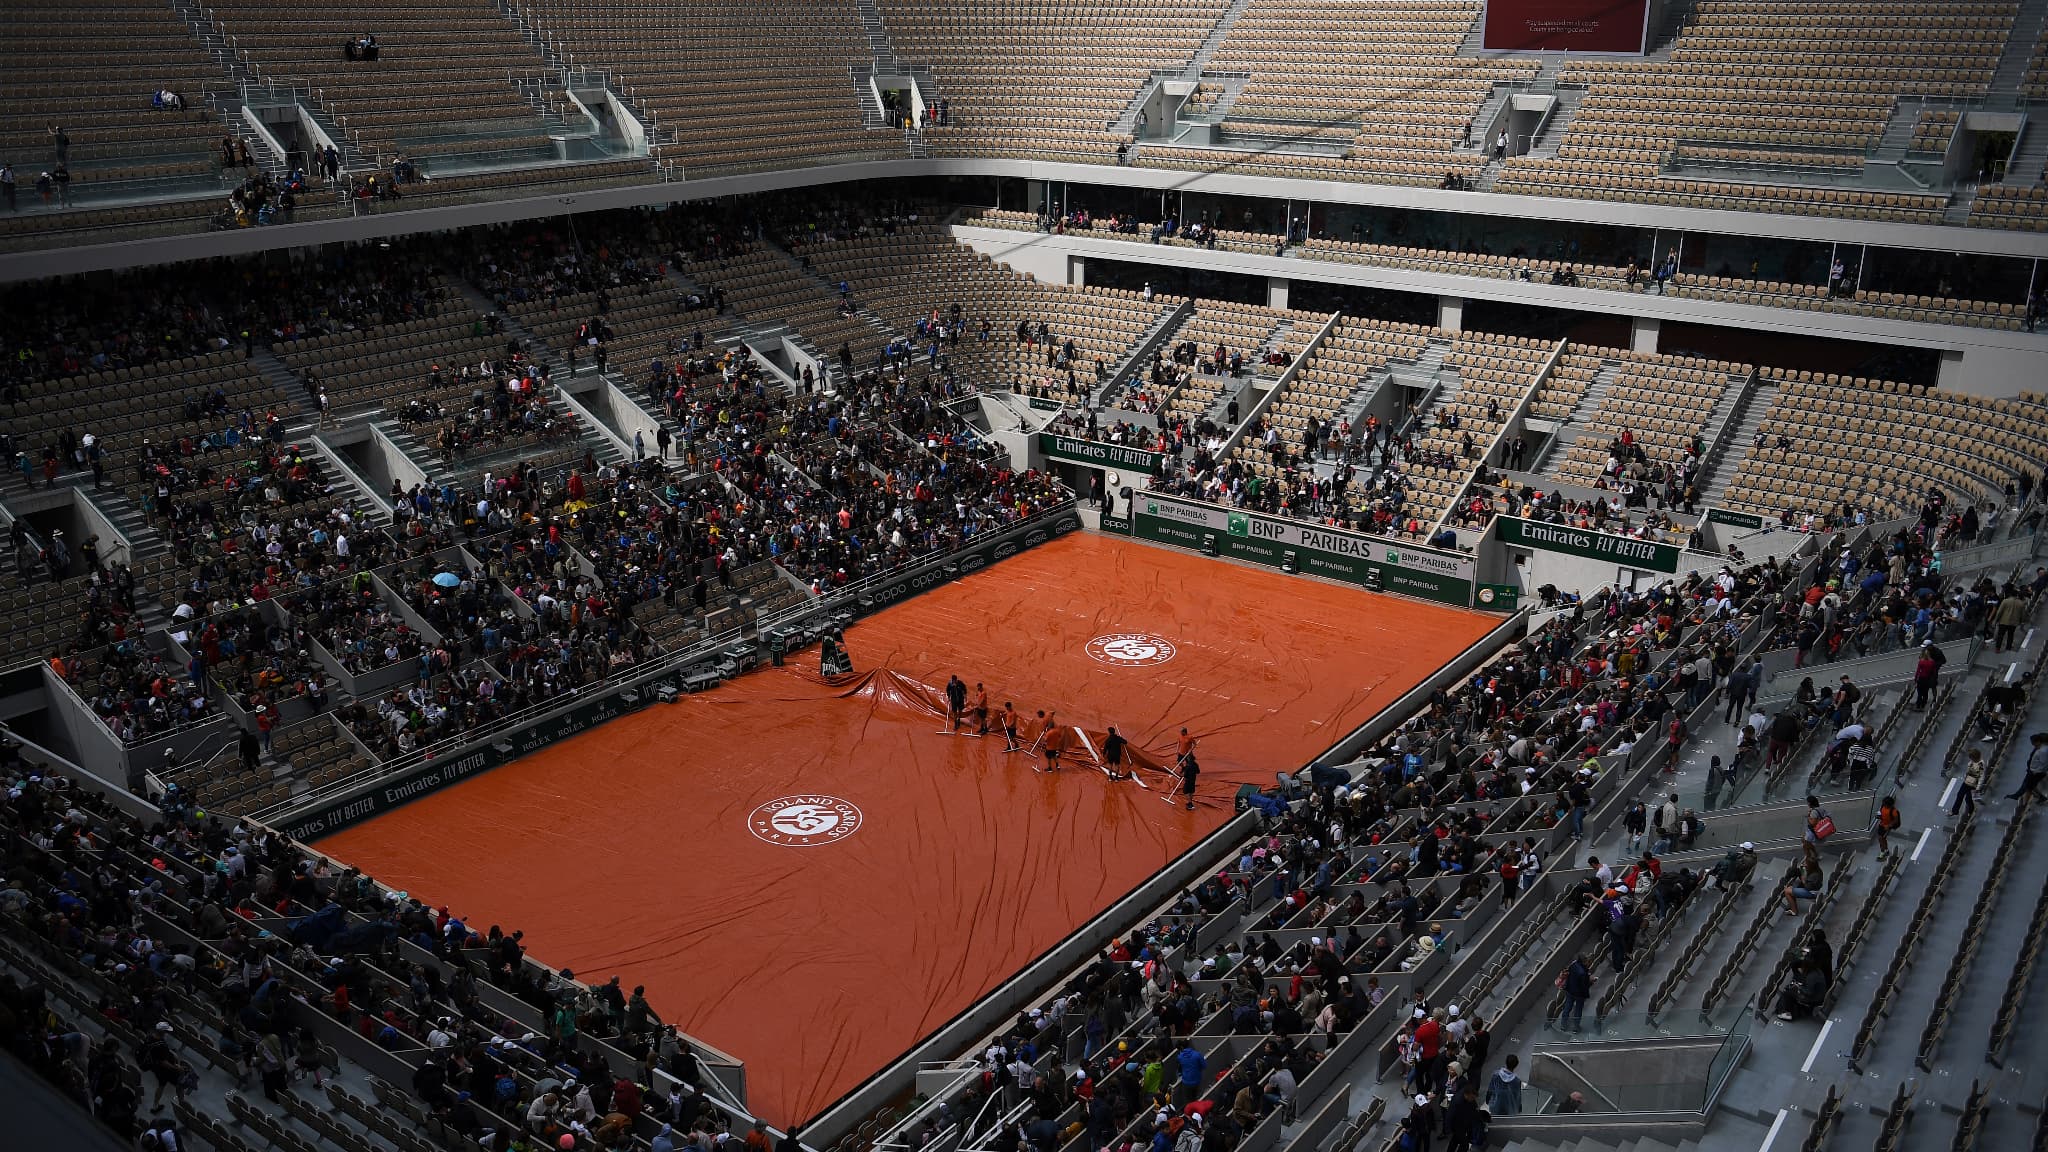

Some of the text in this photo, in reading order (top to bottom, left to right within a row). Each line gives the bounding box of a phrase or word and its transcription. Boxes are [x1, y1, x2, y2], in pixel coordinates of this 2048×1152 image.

[1056, 437, 1152, 467] Emirates FLY BETTER
[1160, 504, 1176, 514] BNP
[1176, 507, 1209, 521] PARIBAS
[1103, 519, 1129, 530] oppo
[1252, 520, 1371, 558] BNP PARIBAS
[1521, 522, 1656, 560] Emirates FLY BETTER
[1401, 552, 1458, 571] BNP PARIBAS
[911, 569, 942, 588] oppo
[1408, 579, 1439, 591] PARIBAS
[875, 584, 907, 604] oppo
[591, 707, 617, 724] ROLEX
[557, 720, 585, 737] ROLEX
[522, 735, 552, 752] ROLEX
[384, 752, 486, 803] Emirates FLY BETTER
[286, 797, 375, 841] irates FLY BETTER
[763, 797, 857, 838] ROLAND GARROS
[757, 820, 810, 843] PARIS
